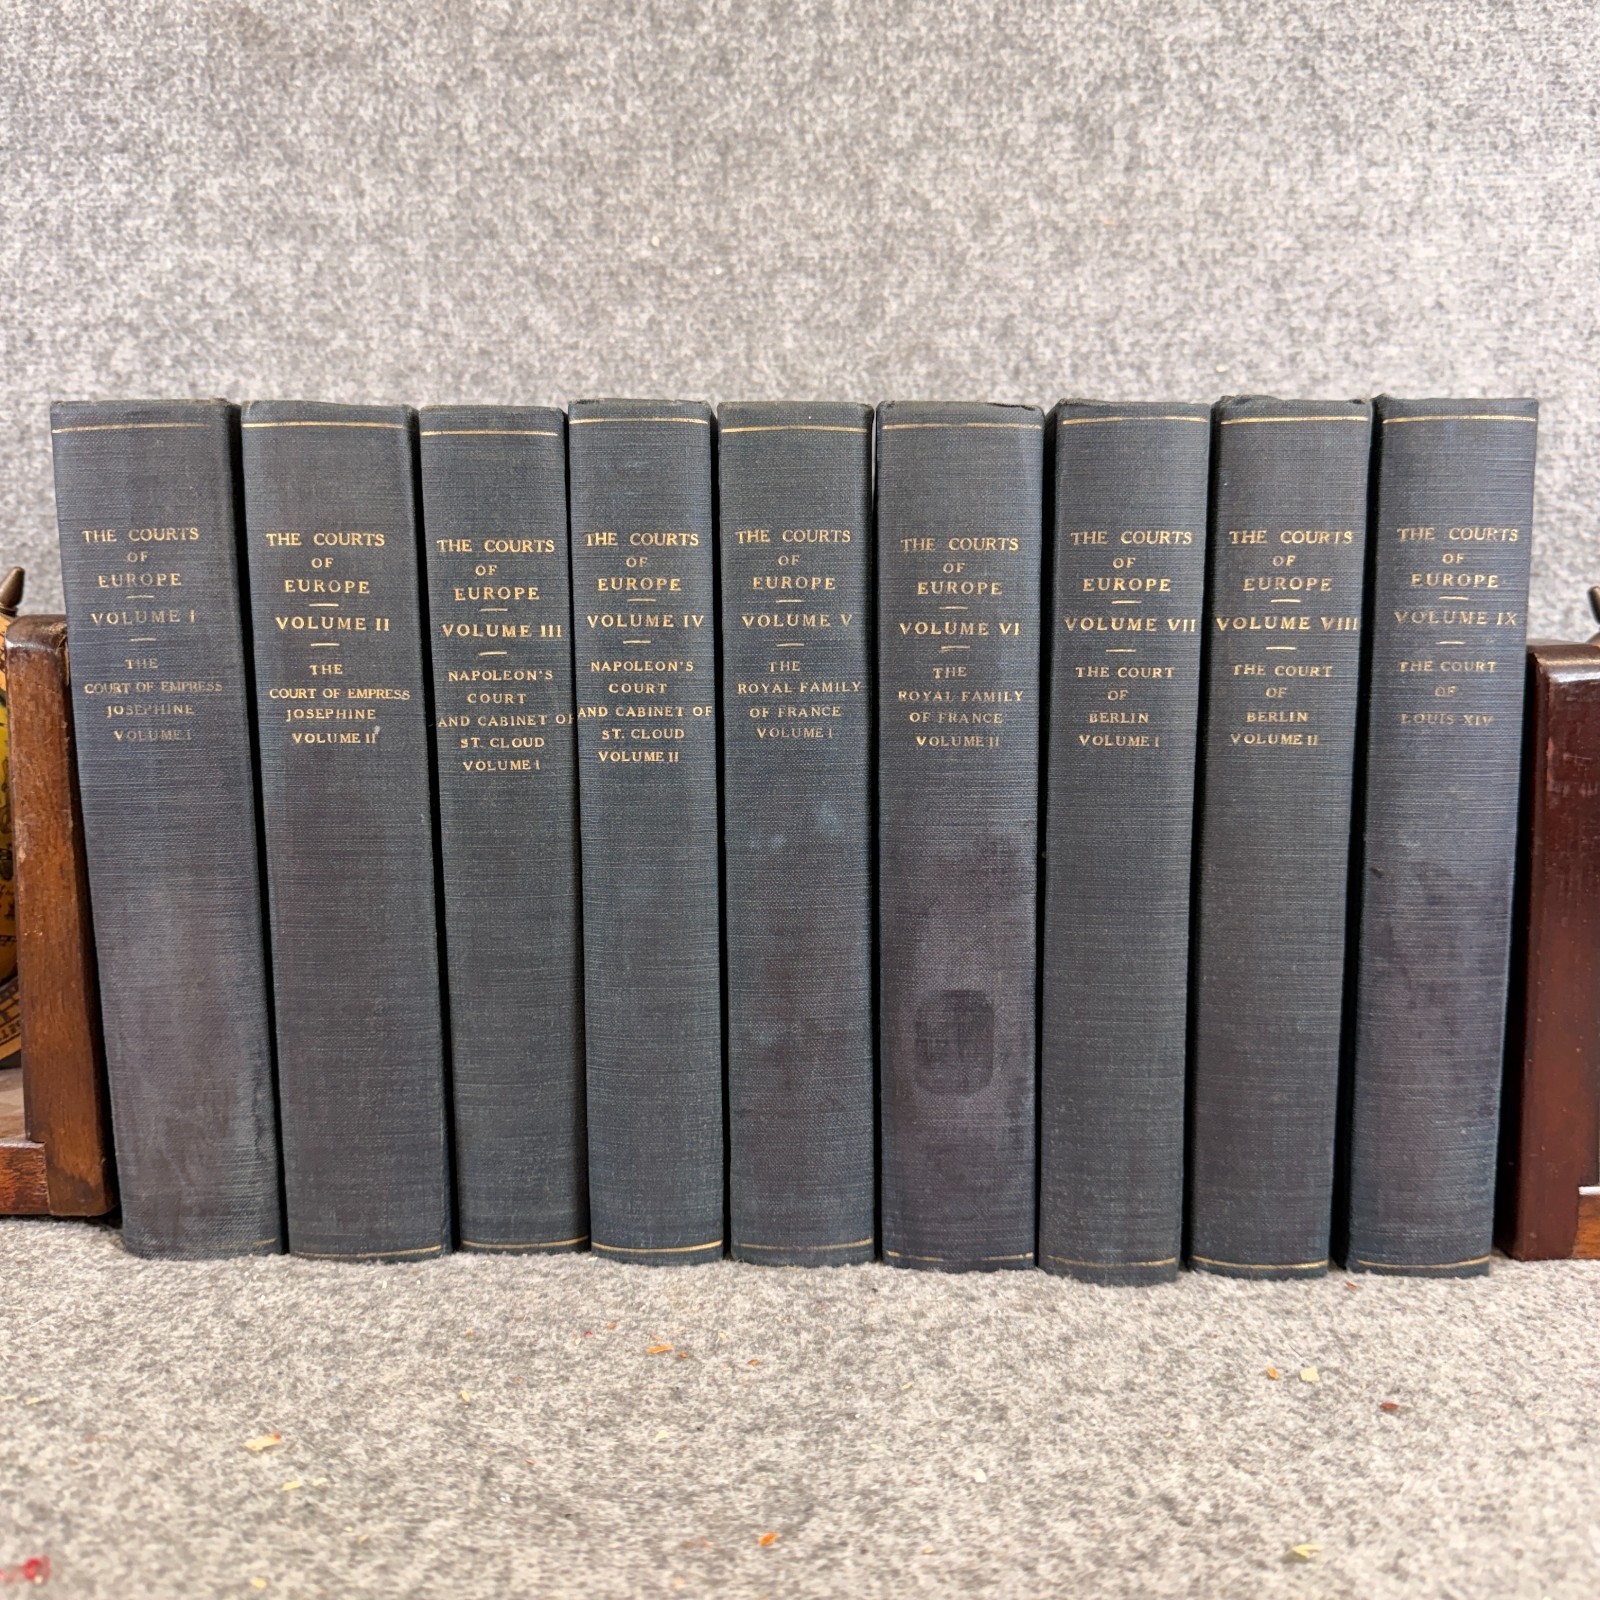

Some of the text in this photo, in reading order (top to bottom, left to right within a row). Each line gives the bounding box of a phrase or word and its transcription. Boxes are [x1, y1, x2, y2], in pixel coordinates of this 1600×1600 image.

[82, 527, 199, 543] THE COURTS
[266, 533, 385, 547] THE COURTS
[584, 533, 699, 547] THE COURTS
[735, 529, 851, 543] THE COURTS
[1071, 531, 1192, 545] THE COURTS
[1229, 530, 1352, 544] THE COURTS
[1397, 527, 1519, 542] THE COURTS
[437, 539, 555, 552] THE COURTS
[900, 538, 1019, 551] THE COURTS
[127, 551, 148, 563] OF
[311, 558, 334, 568] OF
[626, 557, 648, 568] OF
[778, 555, 800, 565] OF
[1113, 557, 1135, 568] OF
[1272, 555, 1295, 566] OF
[1442, 553, 1464, 564] OF
[475, 565, 497, 576] OF
[943, 562, 965, 573] OF
[98, 573, 182, 588] EUROPE
[598, 578, 682, 592] EUROPE
[752, 577, 836, 590] EUROPE
[1083, 578, 1171, 592] EUROPE
[1243, 578, 1332, 591] EUROPE
[1411, 574, 1498, 588] EUROPE
[284, 580, 370, 594] EUROPE
[918, 582, 1002, 595] EUROPE
[454, 587, 539, 600] EUROPE
[91, 610, 196, 624] VOLUME I
[587, 614, 704, 628] VOLUME IV
[742, 614, 852, 628] VOLUME V
[1394, 611, 1517, 625] VOLUME IX
[276, 617, 390, 632] VOLUME II
[900, 622, 1020, 635] VOLUME VI
[1064, 617, 1196, 632] VOLUME VII
[1216, 617, 1358, 631] VOLUME VIII
[442, 624, 562, 638] VOLUME III
[126, 658, 158, 669] THE
[310, 664, 343, 675] THE
[591, 661, 694, 672] NAPOLEON'S
[769, 661, 800, 672] THE
[1399, 661, 1497, 672] THE COURT
[448, 670, 553, 682] NAPOLEON'S
[933, 667, 967, 678] THE
[1076, 667, 1175, 678] THE COURT
[1233, 664, 1333, 677] THE COURT
[84, 681, 222, 694] COURT OF EMPRESS
[608, 683, 668, 693] COURT
[738, 682, 861, 693] ROYAL FAMILY
[1266, 687, 1287, 698] OF
[1434, 686, 1457, 697] OF
[269, 688, 410, 700] COURT OF EMPRESS
[467, 693, 526, 704] COURT
[898, 690, 1023, 701] ROYAL FAMILY
[1107, 690, 1128, 700] OF
[107, 704, 194, 718] JOSEPHINE
[286, 708, 376, 721] JOSEPHINE
[578, 706, 712, 718] AND CABINET OF
[750, 706, 842, 718] OF FRANCE
[1246, 712, 1308, 722] BERLIN
[438, 716, 470, 727] AND
[478, 714, 547, 727] CABINET
[909, 712, 1002, 724] OF FRANCE
[1089, 713, 1149, 723] BERLIN
[1401, 713, 1494, 726] LOUIS XIV
[113, 729, 192, 742] VOLUME I
[292, 732, 377, 744] VOLUME II
[631, 728, 684, 740] CLOUD
[757, 728, 833, 739] VOLUME I
[490, 737, 545, 748] CLOUD
[916, 736, 1000, 747] VOLUME II
[1079, 735, 1159, 747] VOLUME I
[1231, 734, 1318, 746] VOLUME II
[598, 751, 679, 763] VOLUME II
[463, 760, 540, 771] VOLUME I
